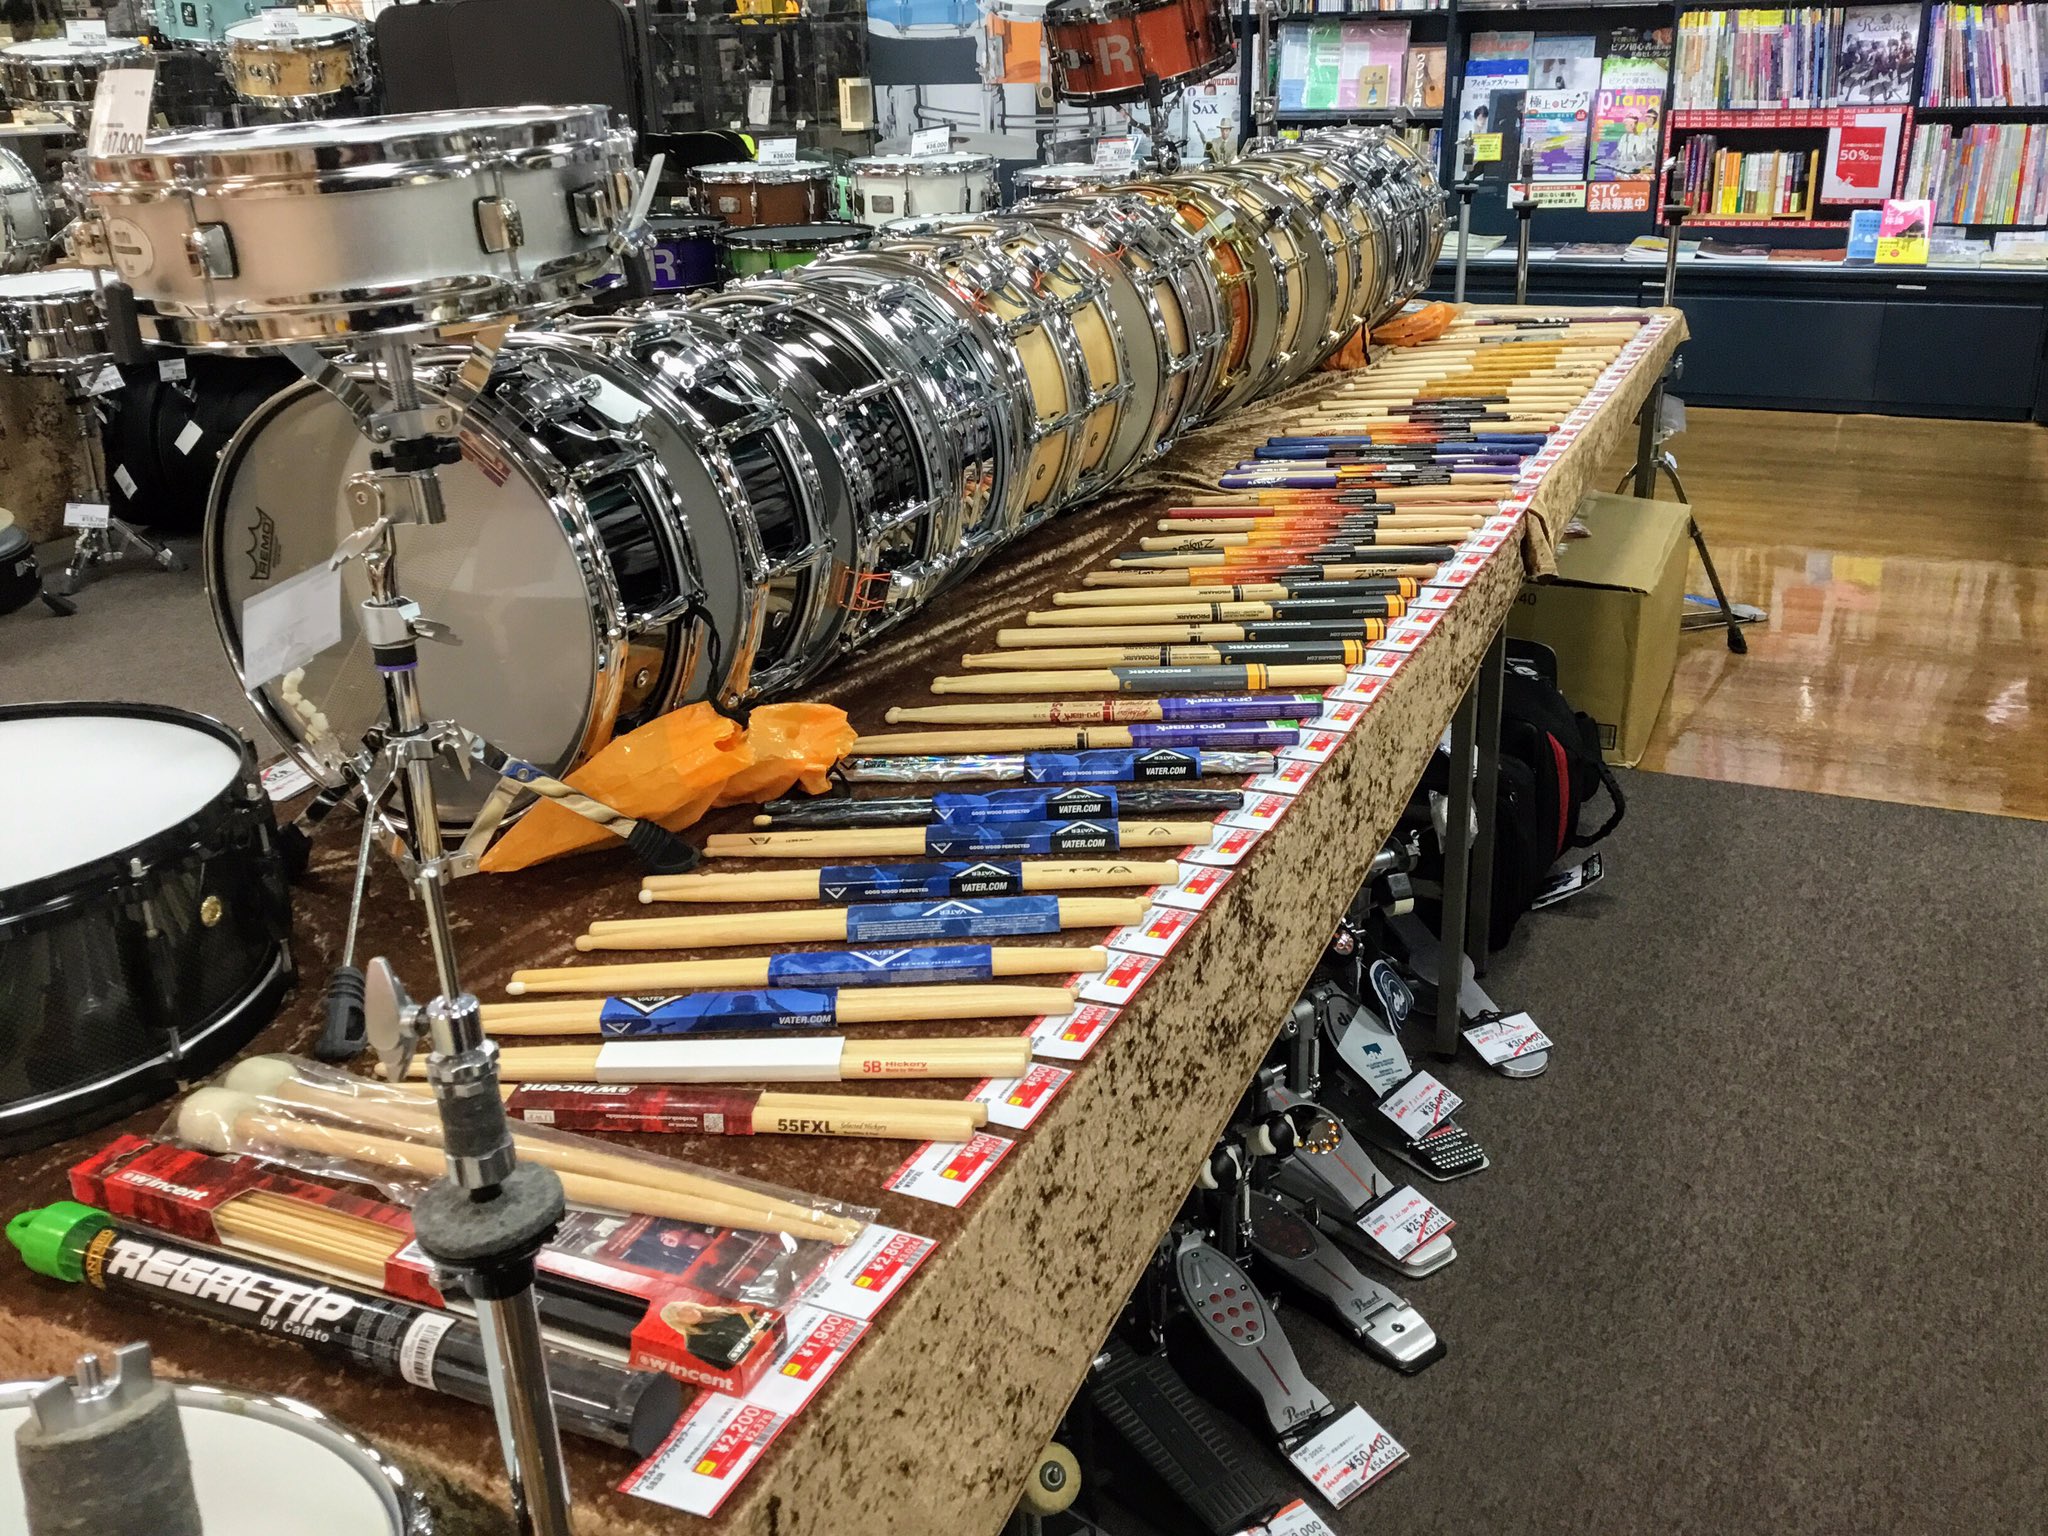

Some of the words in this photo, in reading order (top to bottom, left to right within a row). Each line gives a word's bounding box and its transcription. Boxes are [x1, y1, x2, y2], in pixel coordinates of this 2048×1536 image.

[1857, 18, 1909, 34] Roselia
[1098, 34, 1135, 76] R
[1208, 75, 1238, 87] Journal
[1413, 53, 1426, 108] ウクレレ入門
[1470, 78, 1520, 87] フィギュアスケート
[1134, 99, 1181, 111] Clinet
[1192, 99, 1219, 115] SAX
[1598, 89, 1661, 116] piano
[1840, 149, 1870, 161] 50%
[1591, 184, 1620, 197] STC
[1589, 197, 1646, 210] 会員募集中
[643, 248, 676, 282] R
[259, 520, 273, 575] REMO
[1177, 612, 1211, 620] PROMARK
[1228, 642, 1290, 650] PROMARK
[1146, 767, 1187, 776] VATER.COM
[1058, 804, 1102, 814] VATER.COM
[1061, 838, 1106, 849] VATER.COM
[961, 881, 1008, 892] VATER.COM
[1119, 954, 1141, 971] ¥800
[779, 1014, 832, 1025] VATER.COM
[1075, 1005, 1098, 1025] ¥800
[862, 1060, 882, 1074] 5B
[1023, 1066, 1050, 1087] ¥500
[520, 1083, 621, 1096] wincent
[778, 1119, 836, 1135] 55FXL
[840, 1122, 864, 1130] Selected
[960, 1135, 990, 1159] ¥900
[130, 1173, 209, 1200] wincent
[868, 1235, 910, 1272] ¥2,800
[895, 1240, 921, 1264] ¥3,024
[1351, 1290, 1384, 1315] Pearl
[260, 1315, 279, 1331] by
[282, 1320, 330, 1343] Calato
[735, 1311, 774, 1356] wincent
[797, 1316, 842, 1358] ¥1,900
[826, 1322, 854, 1348] ¥2,052
[650, 1356, 734, 1392] wincent
[1283, 1399, 1316, 1426] Pearl
[712, 1407, 762, 1453] ¥2,200
[745, 1413, 773, 1442] ¥2,376
[632, 1421, 698, 1493] リーガルチップbyカラート
[1294, 1446, 1309, 1460] Pearl
[1346, 1434, 1392, 1470] ¥50,400
[1368, 1446, 1401, 1472] ¥54,432
